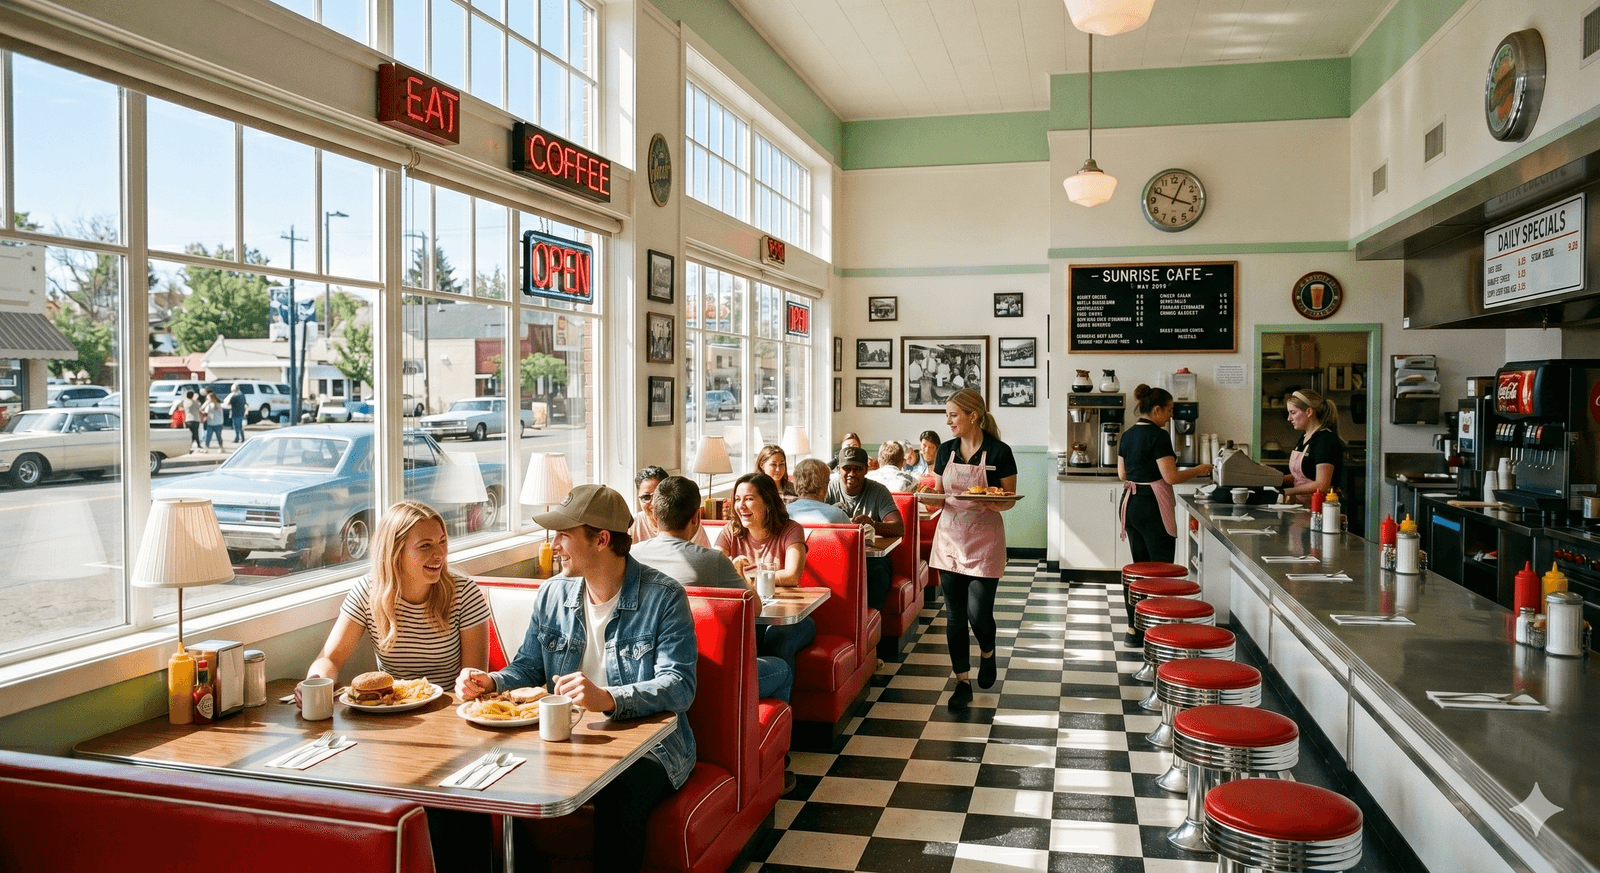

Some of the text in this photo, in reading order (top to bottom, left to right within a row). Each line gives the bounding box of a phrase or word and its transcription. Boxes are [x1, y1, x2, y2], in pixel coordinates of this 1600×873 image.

[407, 76, 459, 133] EAT
[530, 134, 610, 196] COFFEE
[1171, 176, 1178, 184] 12
[1188, 205, 1194, 213] 4
[1192, 195, 1198, 203] 3
[1498, 209, 1566, 252] DAILY SPECIALS
[532, 242, 590, 296] OPEN
[1102, 268, 1202, 283] SUNRISE CAFE
